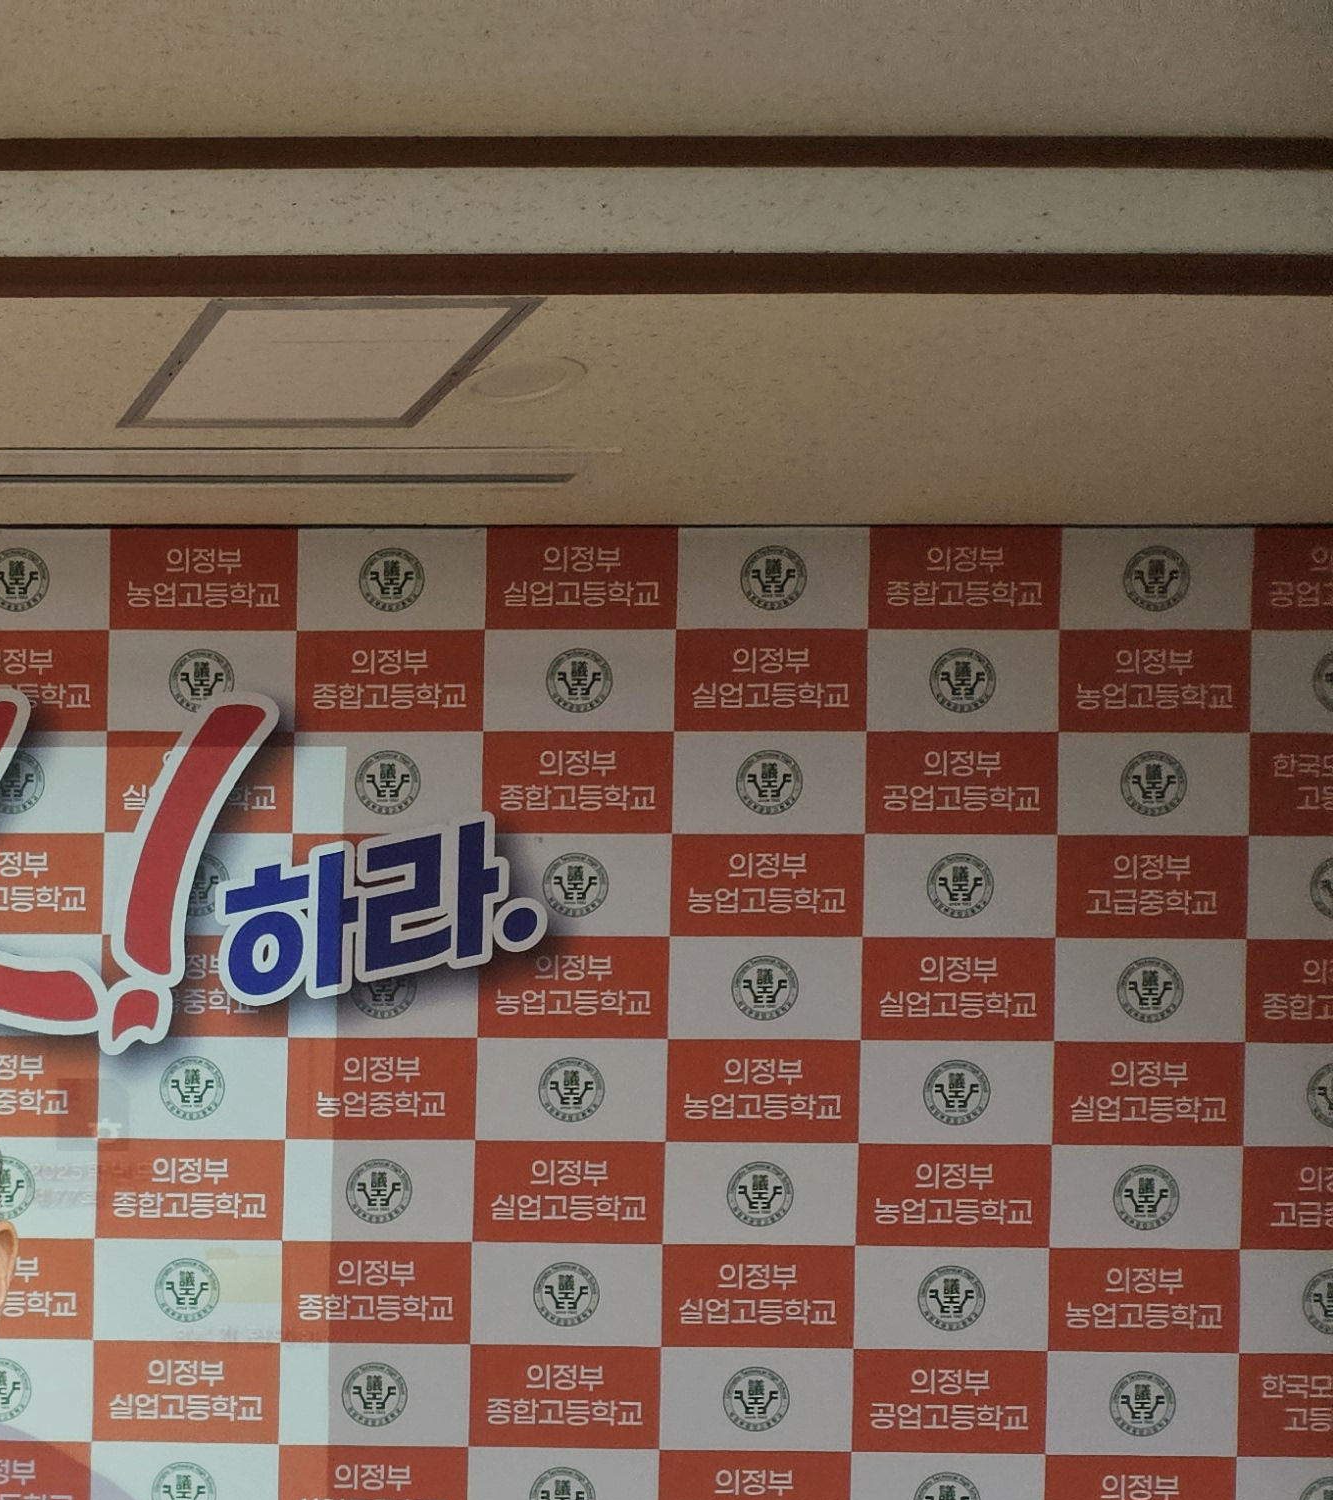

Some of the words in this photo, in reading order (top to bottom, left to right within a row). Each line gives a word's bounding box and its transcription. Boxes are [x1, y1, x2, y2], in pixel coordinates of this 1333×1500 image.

[165, 547, 243, 575] 의정부
[542, 546, 621, 573] 의정부
[126, 581, 281, 609] 농업고등학교
[503, 580, 661, 608] 실업고등학교
[350, 649, 429, 676] 의정부
[731, 647, 810, 674] 의정부
[312, 682, 467, 710] 종합고등학교
[691, 681, 850, 709] 실업고등학교
[923, 750, 1002, 778] 의정부
[882, 784, 1041, 812] 공업고등학교
[728, 852, 807, 880] 의정부
[219, 815, 543, 1001] 하라.
[687, 887, 846, 915] 농업고등학교
[534, 953, 612, 981] 의정부
[919, 956, 998, 984] 의정부
[495, 989, 651, 1016] 농업고등학교
[879, 991, 1038, 1019] 실업고등학교
[342, 1056, 421, 1083] 의정부
[723, 1058, 803, 1085] 의정부
[314, 1089, 446, 1120] 농업중학교
[683, 1093, 842, 1121] 농업고등학교
[151, 1157, 229, 1185] 의정부
[530, 1159, 609, 1187] 의정부
[914, 1162, 994, 1191] 의정부
[111, 1190, 267, 1220] 종합고등학교
[490, 1194, 647, 1222] 실업고등학교
[873, 1197, 1033, 1226] 농업고등학교
[337, 1260, 416, 1287] 의정부
[717, 1263, 798, 1291] 의정부
[296, 1292, 454, 1322] 종합고등학교
[678, 1298, 837, 1326] 실업고등학교
[525, 1363, 604, 1392] 의정부
[910, 1368, 990, 1397] 의정부
[485, 1397, 644, 1427] 종합고등학교
[869, 1402, 1029, 1432] 공업고등학교
[333, 1464, 412, 1491] 의정부
[714, 1468, 794, 1497] 의정부
